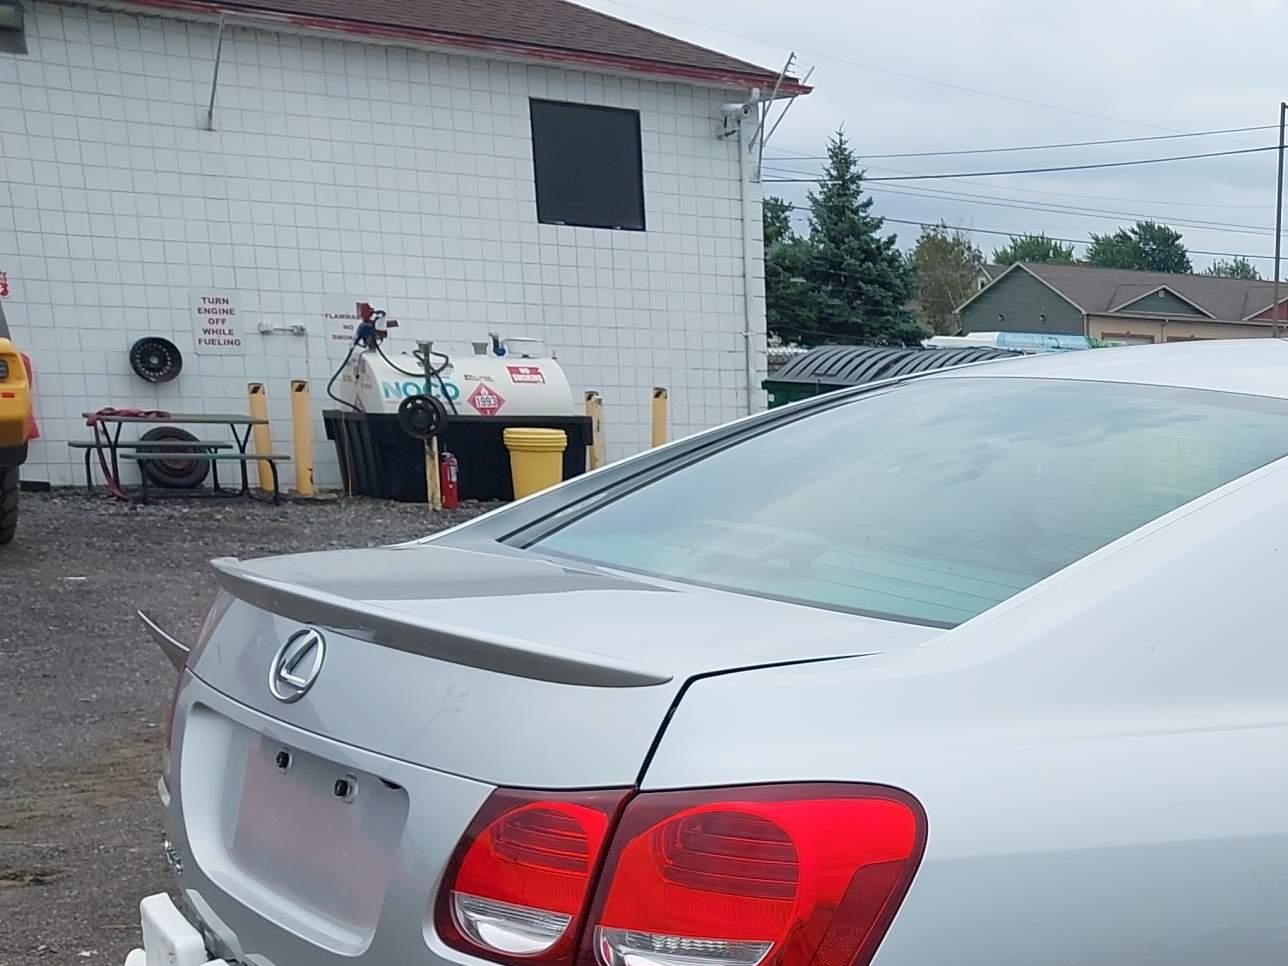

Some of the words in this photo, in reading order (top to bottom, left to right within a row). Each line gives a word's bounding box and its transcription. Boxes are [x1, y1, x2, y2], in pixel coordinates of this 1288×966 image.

[201, 296, 229, 305] TURN
[197, 307, 236, 315] ENGINE
[208, 317, 227, 325] OFF
[202, 328, 234, 336] WHILE
[198, 338, 241, 346] FUELING
[476, 396, 497, 407] 1993
